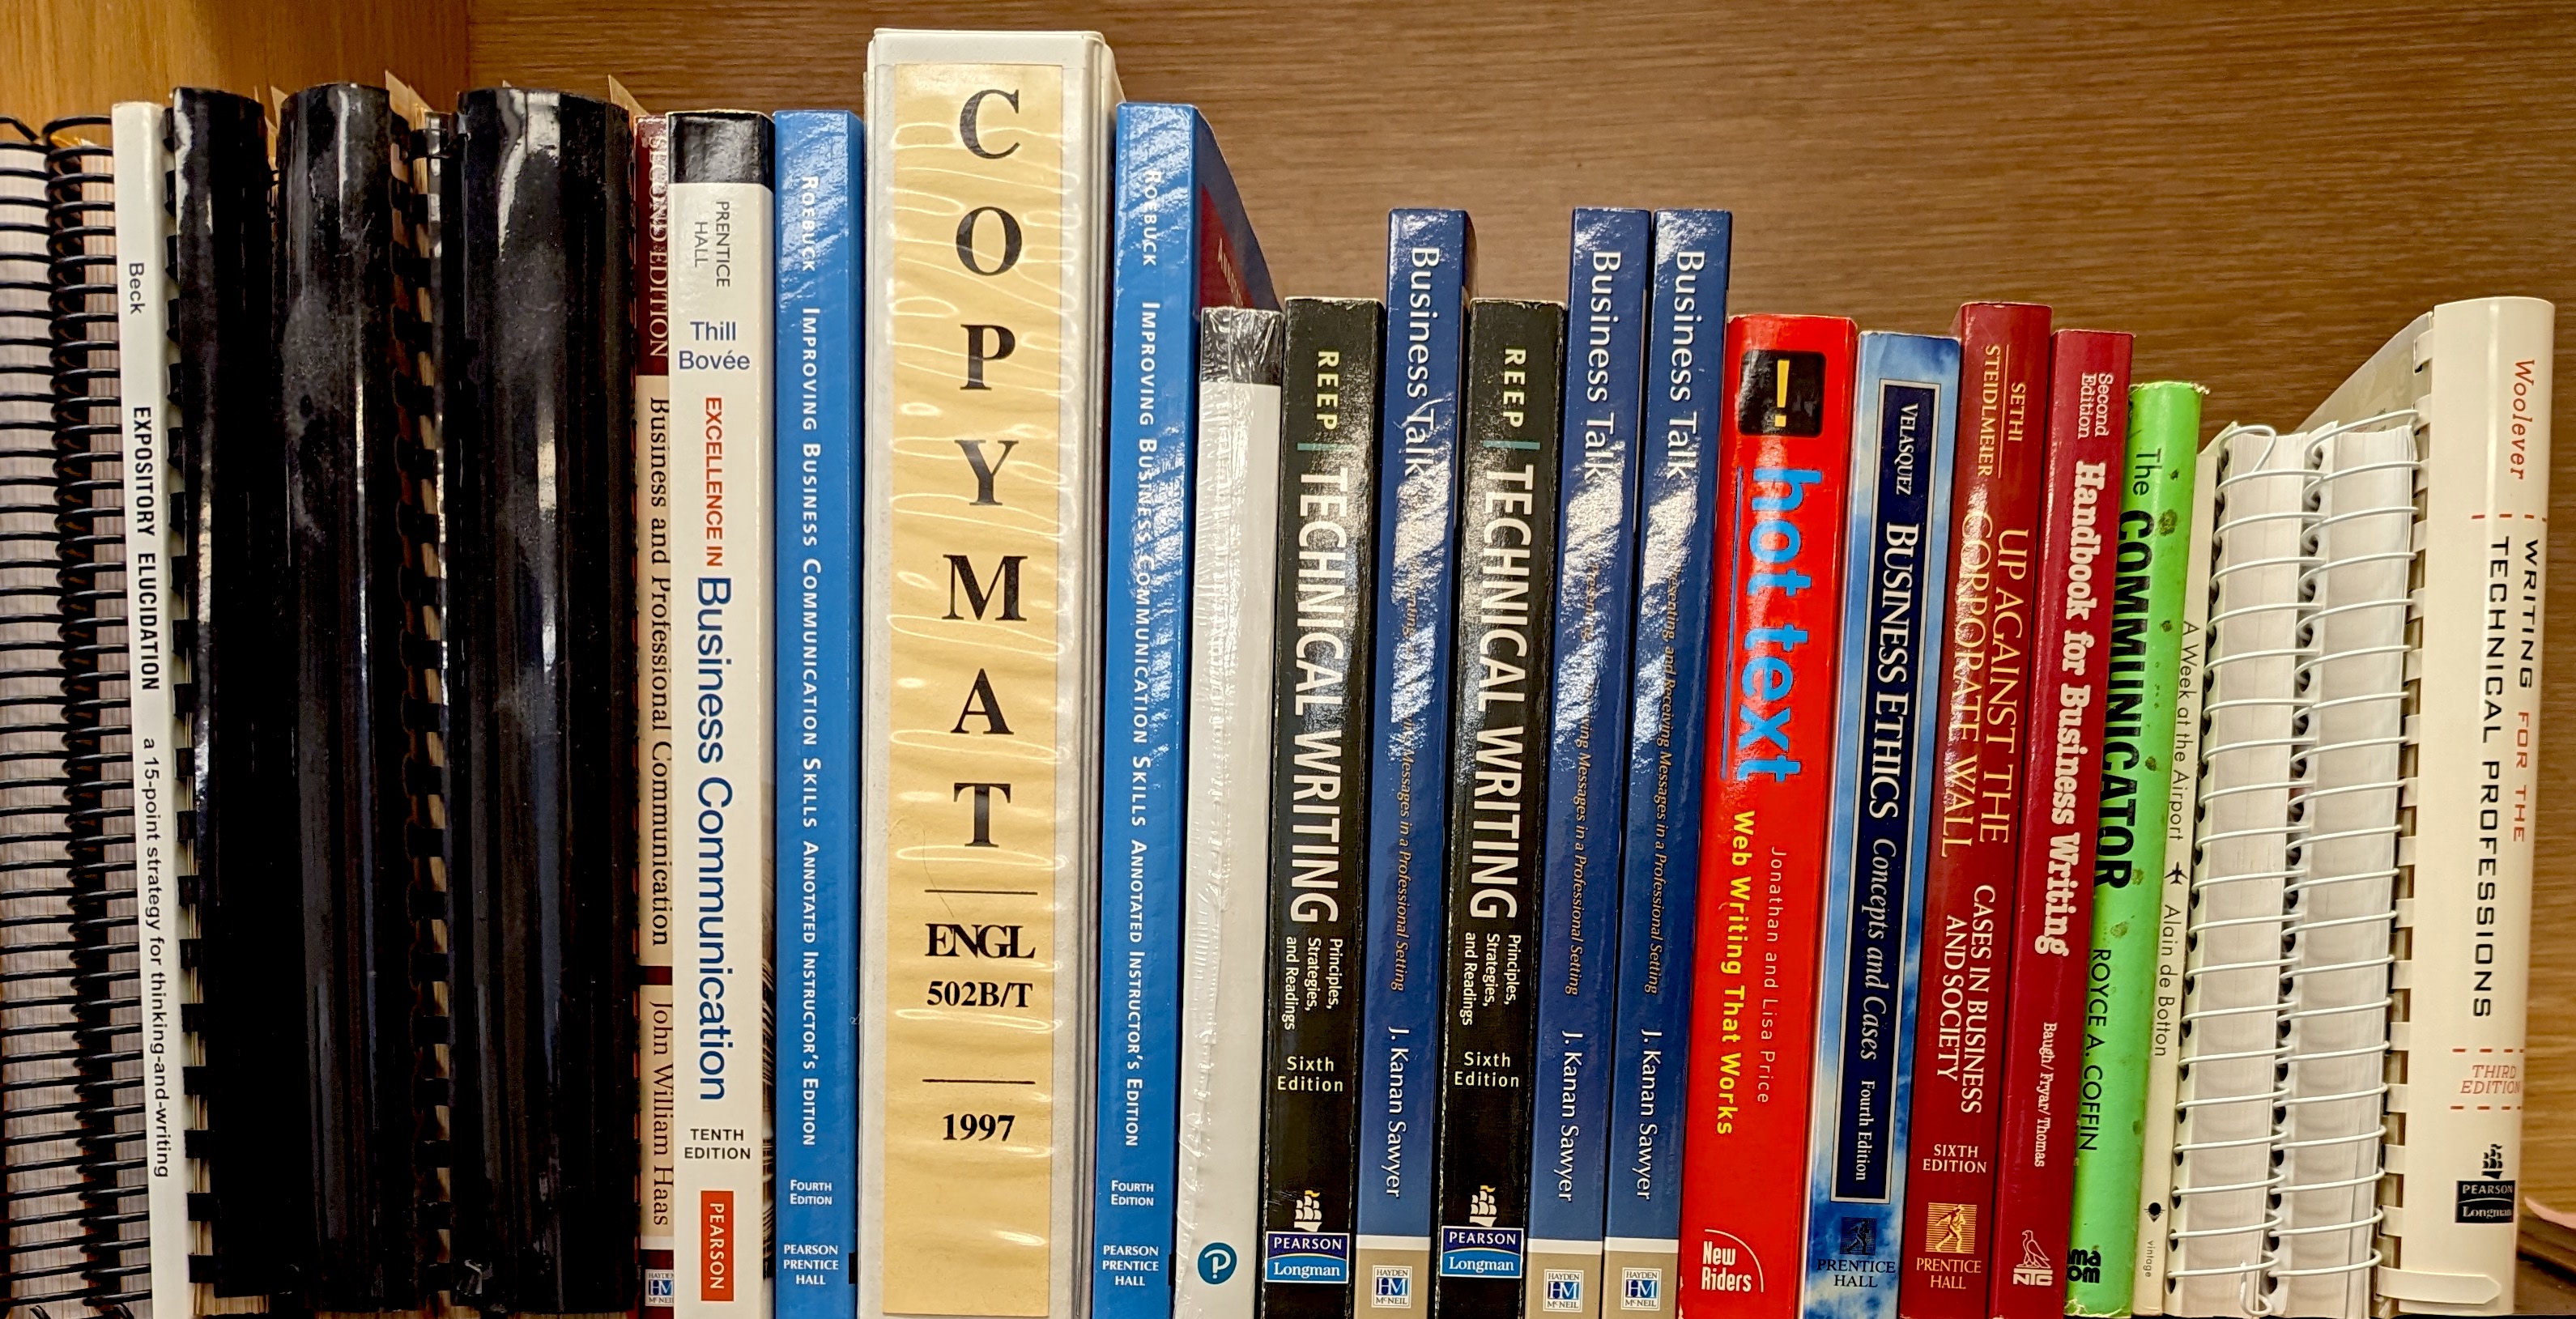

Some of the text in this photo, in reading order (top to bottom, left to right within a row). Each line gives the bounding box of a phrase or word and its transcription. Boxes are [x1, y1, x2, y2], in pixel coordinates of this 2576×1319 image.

[694, 220, 707, 268] HALL
[716, 200, 730, 287] PRENTICE
[129, 262, 146, 315] Beck
[649, 251, 668, 357] EDITION
[679, 349, 751, 371] Bovée
[690, 321, 737, 343] Thill
[803, 309, 820, 431] IMPROVING
[1140, 303, 1160, 425] IMPROVING
[1403, 247, 1441, 477] Business Talk
[1583, 251, 1621, 481] Business Talk
[1667, 251, 1705, 479] Business Talk
[1317, 351, 1340, 430] REEP
[1503, 349, 1526, 428] REEP
[1977, 345, 2001, 477] STEIDLMEIER
[2008, 381, 2026, 442] SETHI
[2078, 372, 2097, 439] Edition
[2095, 372, 2114, 437] Second
[2510, 359, 2535, 479] Woolever
[705, 397, 723, 567] EXCELLENCE IN
[1894, 403, 1918, 495] VELASQUEZ
[803, 444, 820, 547] BUSINESS
[133, 406, 160, 691] EXPOSITORY ELUCIDATION
[802, 560, 820, 746] COMMUNICATION
[1665, 645, 1676, 675] and
[1738, 466, 1823, 782] hot text
[650, 398, 673, 947] Business and Professional Communication
[1291, 467, 1348, 923] TECHNICAL WRITING
[1471, 464, 1534, 919] TECHNICAL WRITING
[1869, 522, 1918, 818] BUSINESS ETHICS
[1941, 512, 1994, 857] CORPORATE WALL
[1978, 528, 2029, 844] UP AGAINST THE
[2094, 448, 2162, 890] The COMMUNICATOR
[2513, 539, 2538, 843] WRITING FOR THE
[1656, 679, 1675, 747] Receiving
[2034, 460, 2106, 957] Handbook for Business Writing
[2169, 621, 2200, 840] A Week at the Airport
[803, 758, 820, 828] SKILLS
[1652, 752, 1672, 820] Messages
[2473, 536, 2509, 1018] TECHNICAL PROFESSIONS
[698, 577, 734, 1101] Business Communication
[803, 841, 817, 943] ANNOTATED
[1650, 852, 1667, 940] Professional
[143, 738, 169, 1179] a 15-point strategy for thinking-and-writing
[926, 924, 1035, 959] ENGL
[1305, 938, 1322, 1011] Strategies,
[1326, 938, 1343, 1009] Principles,
[1644, 942, 1663, 995] Setting
[1716, 811, 1754, 1134] Web Writing That Works
[1756, 846, 1786, 1104] Jonathan and Lisa Price
[1861, 838, 1898, 1060] Concepts and Cases
[927, 981, 1033, 1009] 502B/T
[1282, 936, 1299, 1030] and Readings
[1936, 915, 1969, 1081] AND SOCIETY
[1961, 884, 1995, 1113] CASES IN BUSINESS
[2154, 904, 2182, 1057] Alain de Botton
[1278, 1076, 1343, 1091] Edition
[1287, 1056, 1334, 1071] Sixth
[2079, 949, 2111, 1151] ROYCE A. COFFIN
[2460, 1080, 2521, 1094] EDITION
[2472, 1065, 2516, 1079] THIRD
[649, 1000, 674, 1226] John William Haas
[691, 1128, 744, 1142] TENTH
[803, 1079, 819, 1146] EDITION
[943, 1114, 1015, 1142] 1997
[1635, 1029, 1662, 1201] J. Kanan Sawyer
[1855, 1080, 1876, 1181] Fourth Edition
[1933, 1144, 1978, 1157] SIXTH
[683, 1147, 752, 1160] EDITION
[790, 1180, 832, 1192] FOURTH
[1922, 1159, 1987, 1173] EDITION
[2462, 1184, 2513, 1193] PEARSON
[790, 1194, 832, 1205] EDITION
[709, 1202, 724, 1291] PEARSON
[783, 1258, 838, 1271] PRENTICE
[784, 1244, 838, 1256] PEARSON
[1274, 1236, 1341, 1250] PEARSON
[1274, 1262, 1340, 1278] Longman
[1449, 1232, 1516, 1245] PEARSON
[1449, 1257, 1514, 1272] Longman
[1703, 1241, 1735, 1265] New
[1817, 1258, 1896, 1274] PRENTICE
[1916, 1258, 1981, 1274] PRENTICE
[2143, 1240, 2153, 1278] vintage
[796, 1274, 825, 1286] HALL
[1701, 1266, 1752, 1291] Riders
[1833, 1274, 1878, 1288] HALL
[1930, 1274, 1967, 1289] HALL
[2013, 1268, 2053, 1286] NTC
